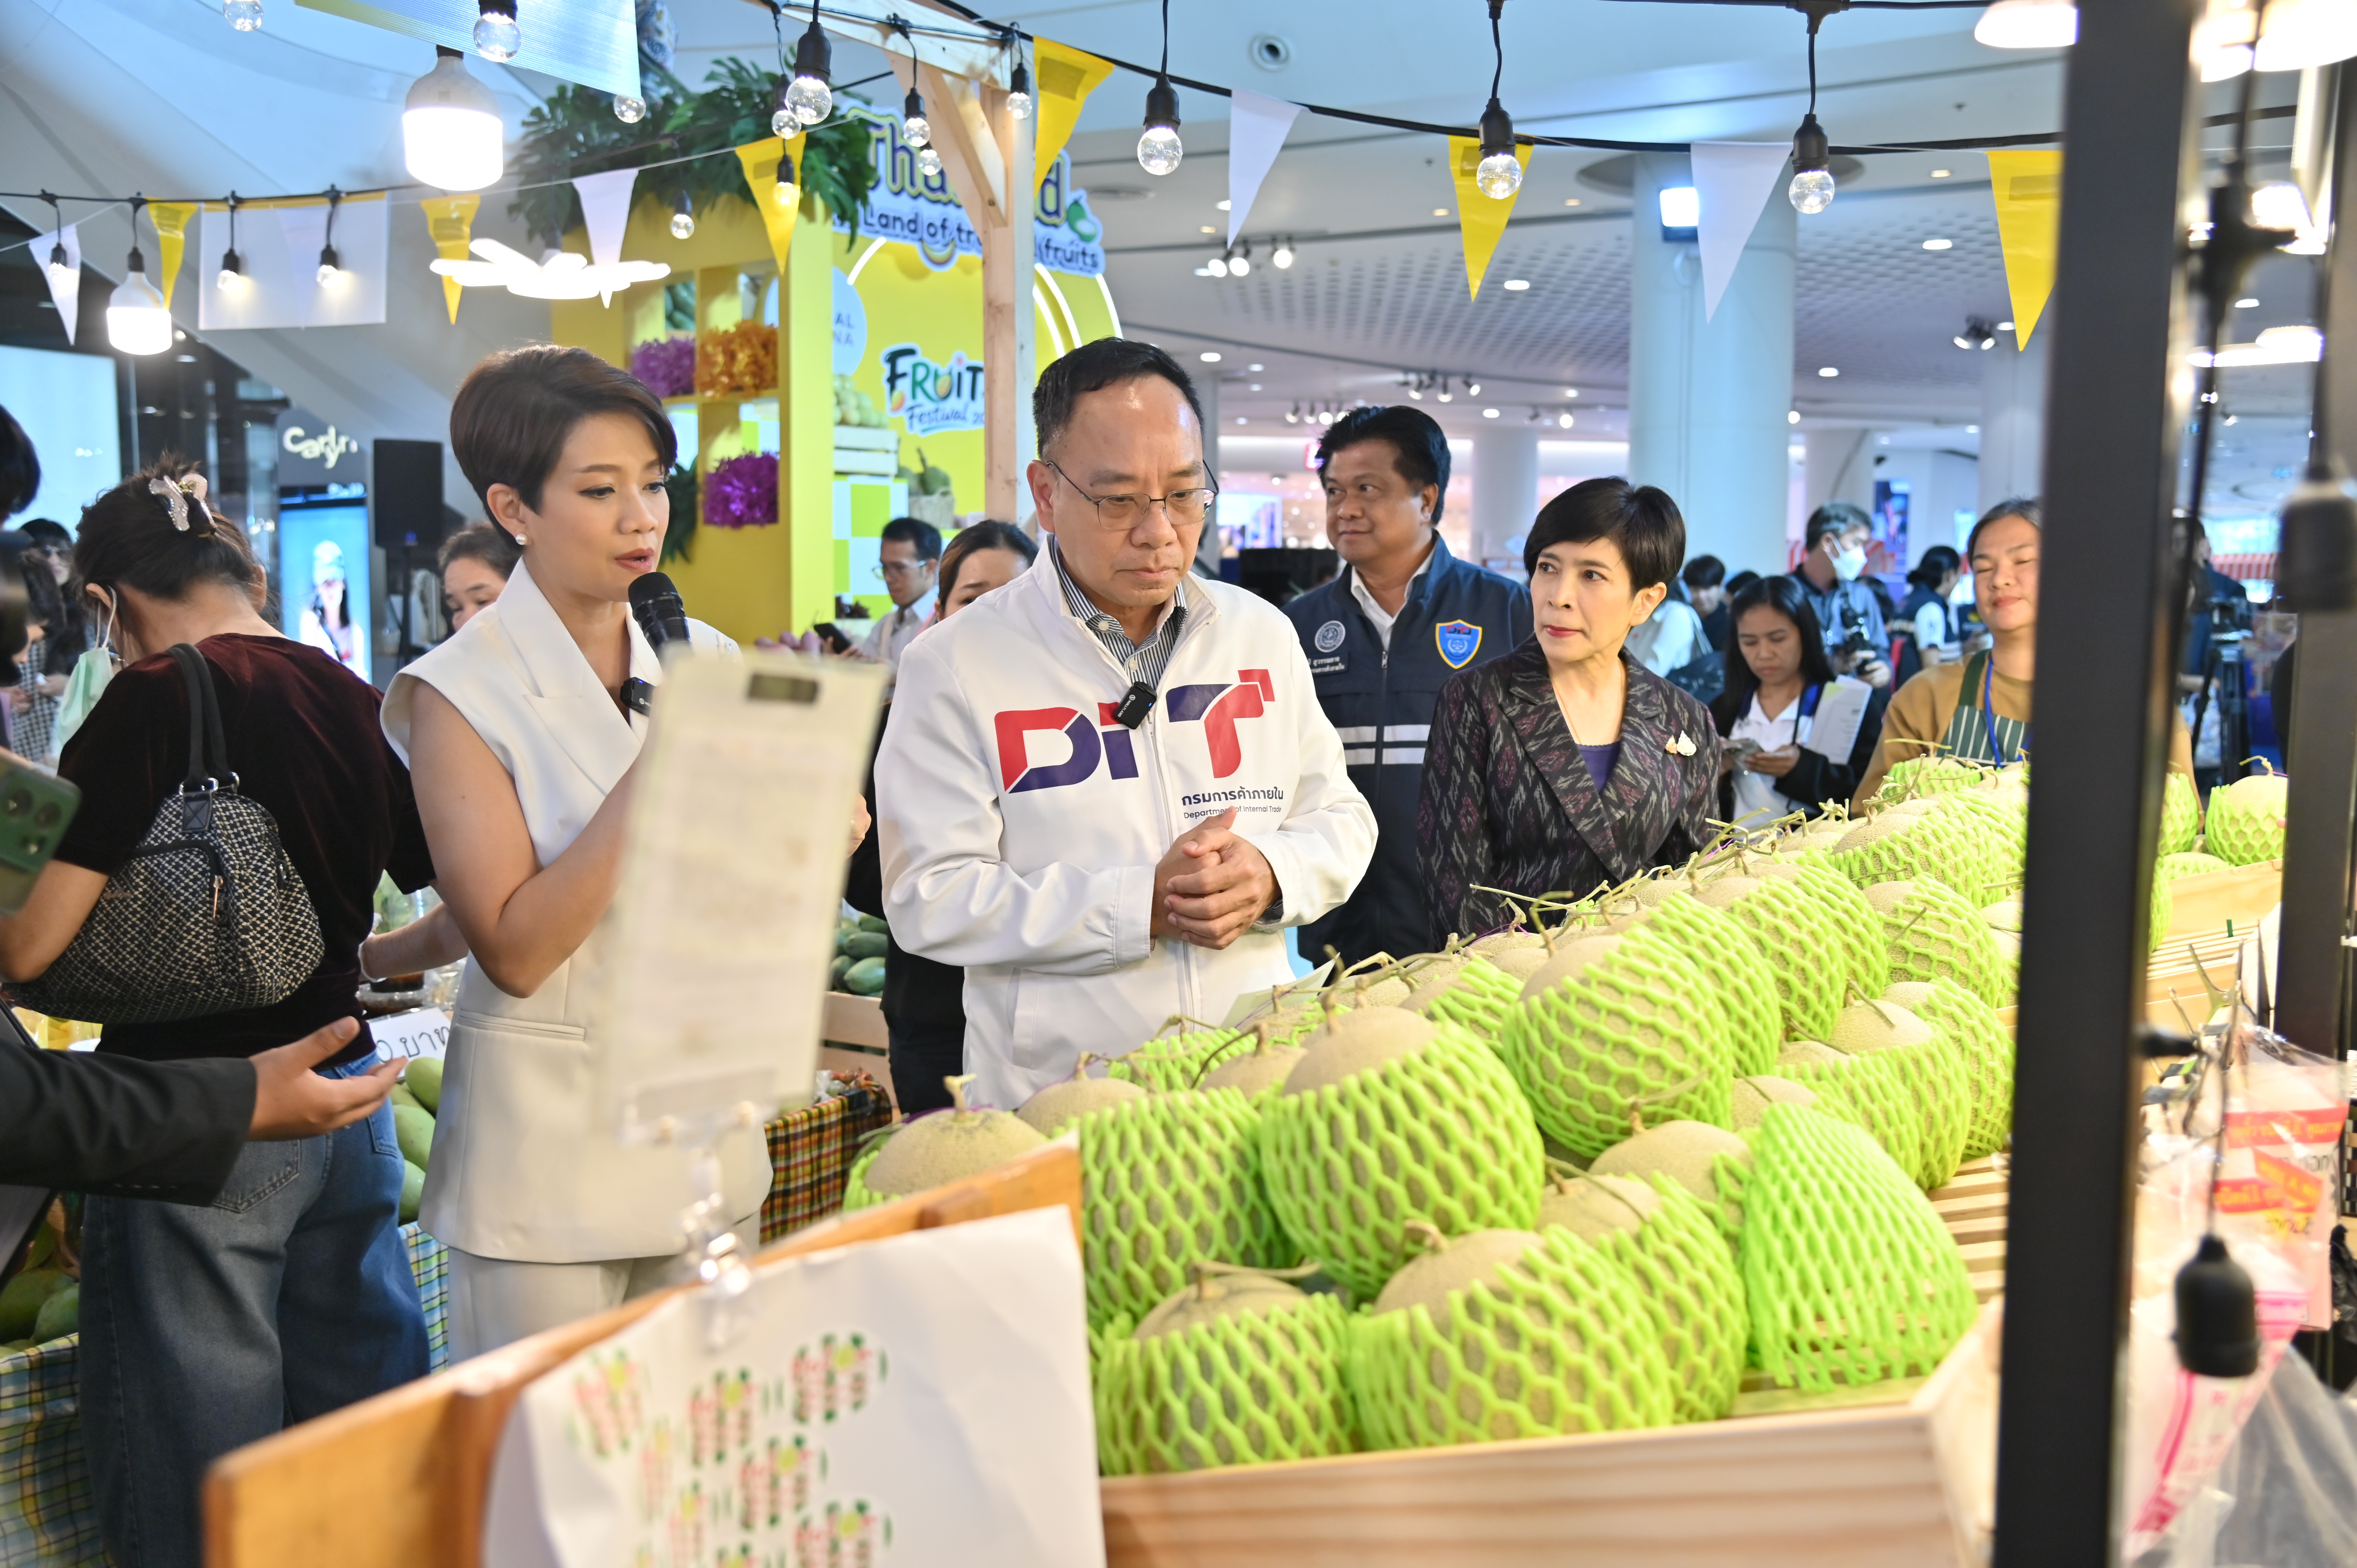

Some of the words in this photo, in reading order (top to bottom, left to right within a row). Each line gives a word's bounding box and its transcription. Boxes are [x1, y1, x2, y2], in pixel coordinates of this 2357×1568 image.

[926, 217, 949, 238] of
[1044, 238, 1099, 268] fruits
[906, 402, 969, 428] Festival
[1117, 700, 1131, 717] HOLLYLAND
[1182, 786, 1283, 806] กรมการค้าภายใน
[1184, 808, 1227, 819] Departme
